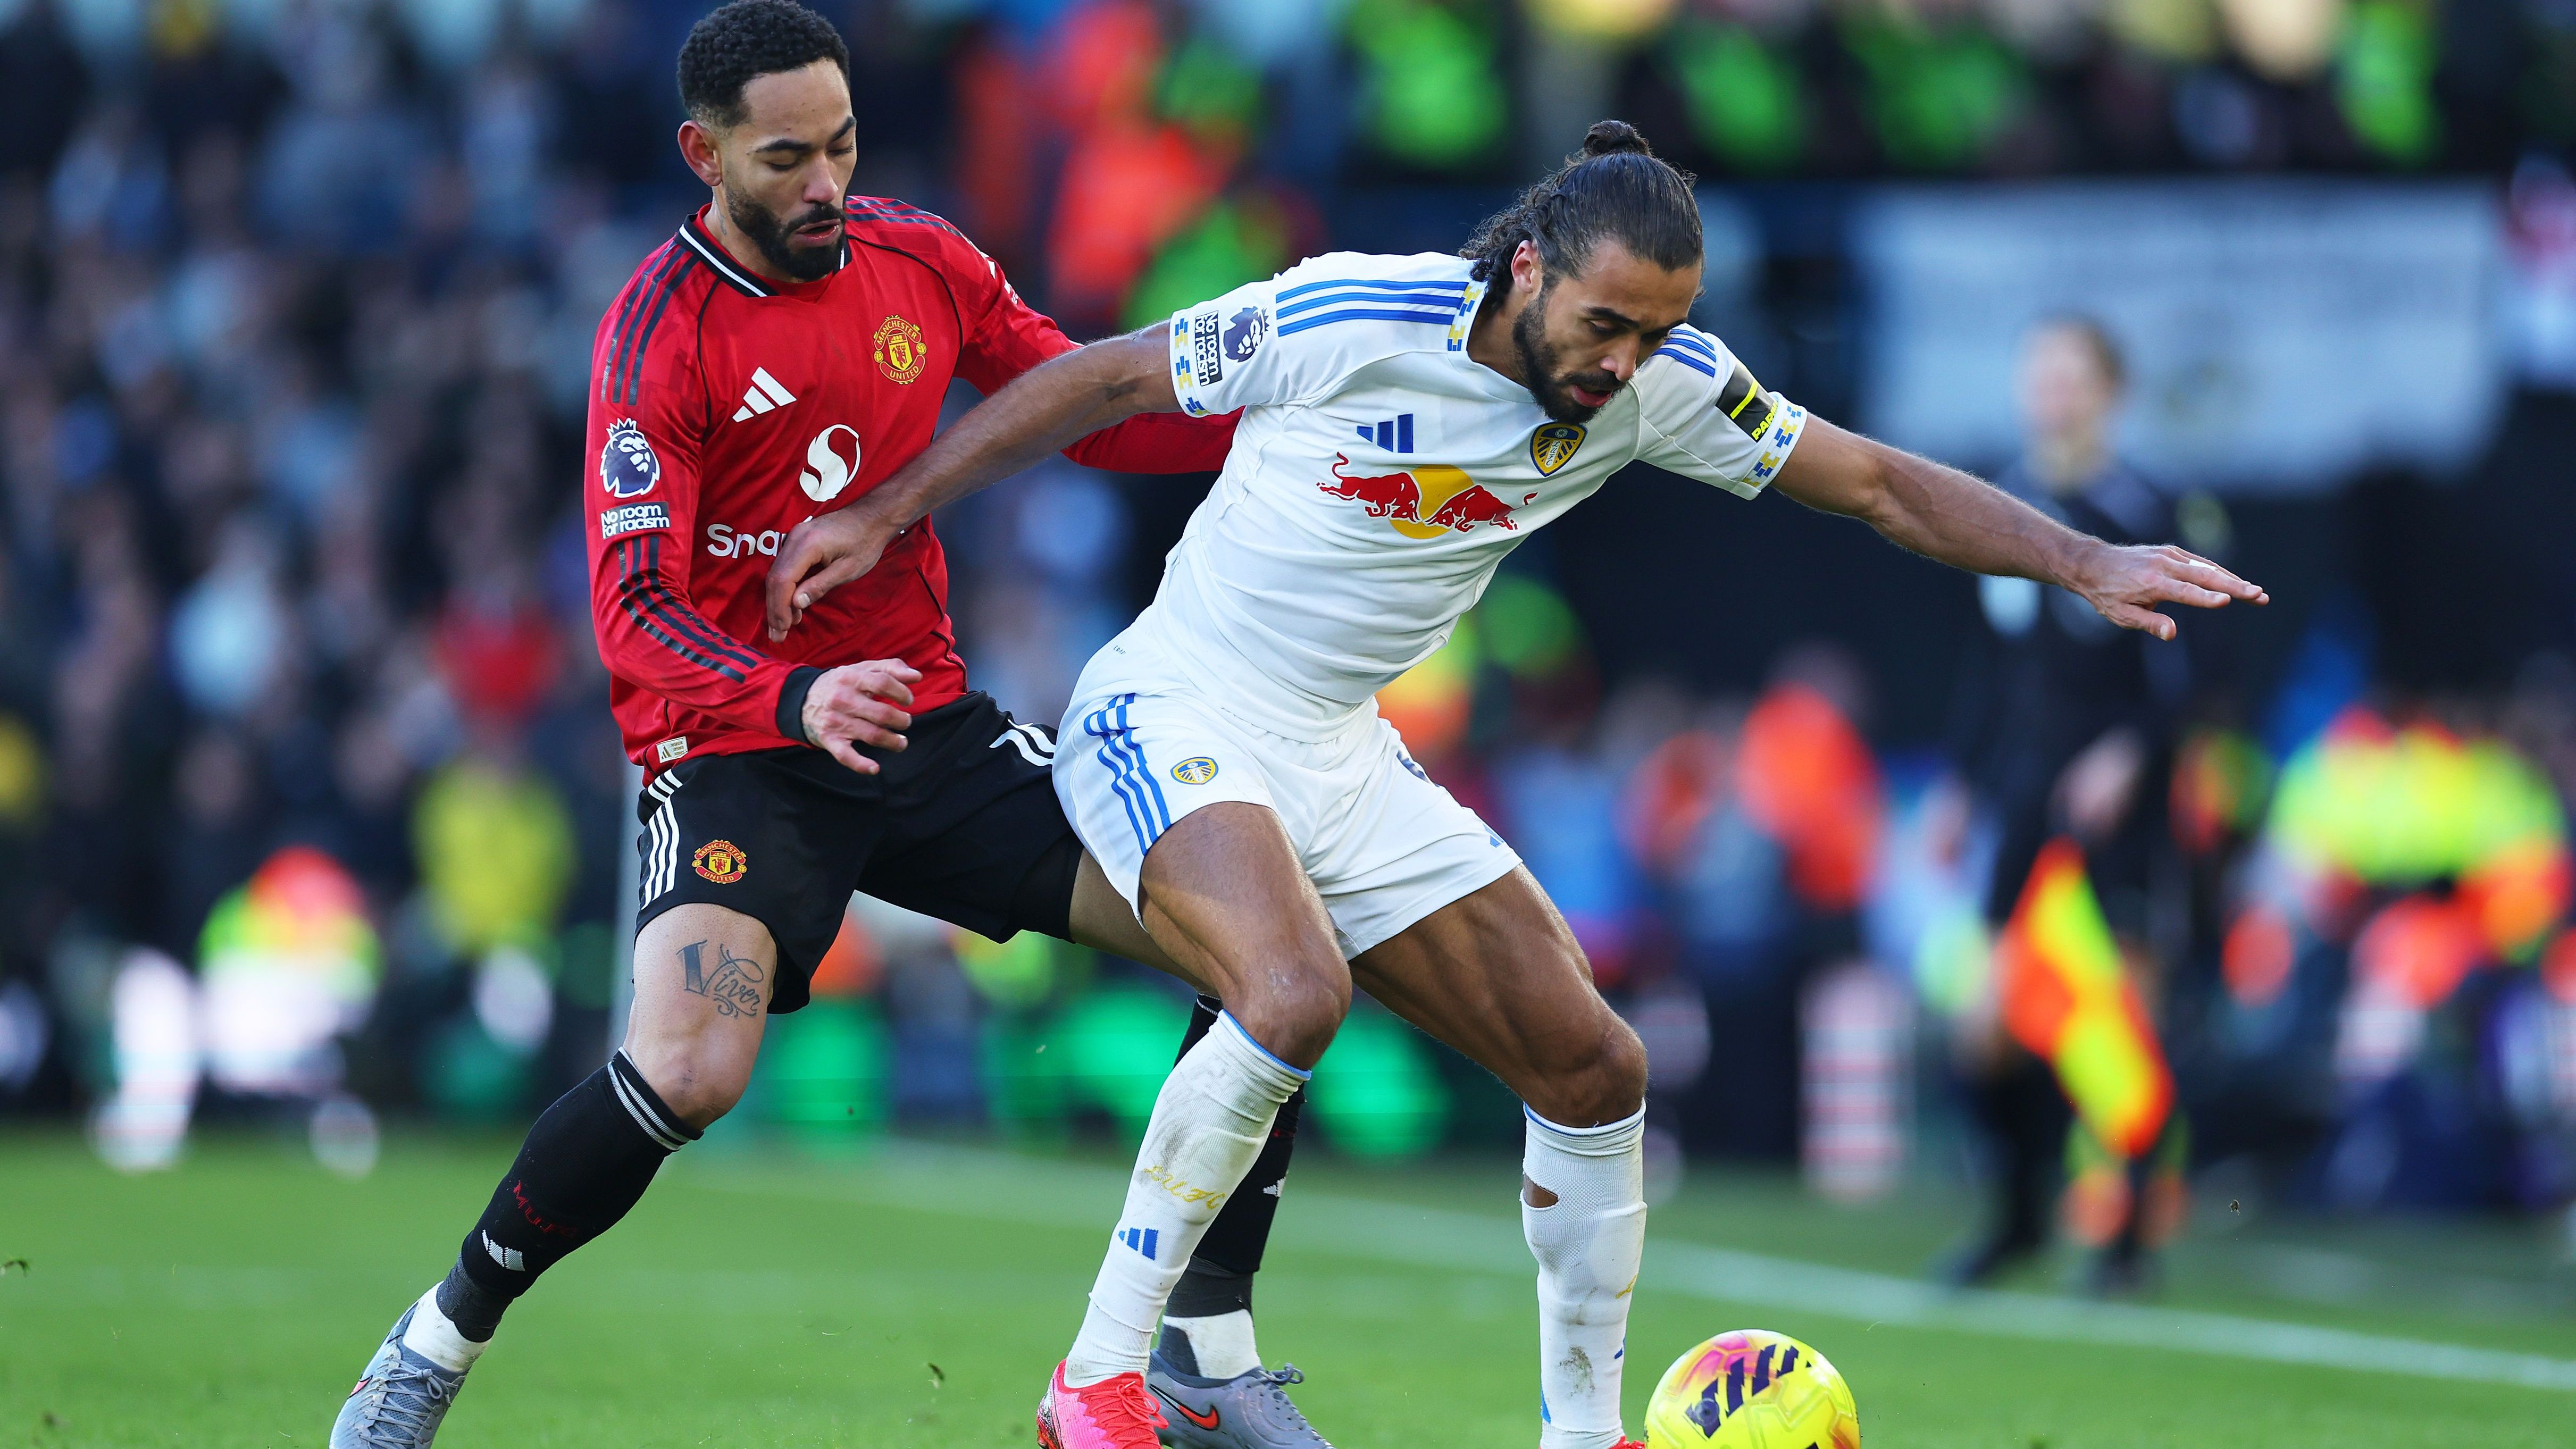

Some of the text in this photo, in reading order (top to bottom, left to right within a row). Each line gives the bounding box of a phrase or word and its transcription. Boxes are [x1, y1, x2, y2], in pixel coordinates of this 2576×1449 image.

[876, 320, 917, 345] MANCHESTER
[1206, 311, 1219, 376] No room
[1196, 336, 1210, 387] racism
[890, 365, 919, 380] UNITED
[601, 505, 662, 526] No room
[620, 516, 670, 532] racism
[707, 523, 788, 558] Sna
[698, 843, 742, 861] MANCHESTER
[704, 872, 734, 881] UNITED
